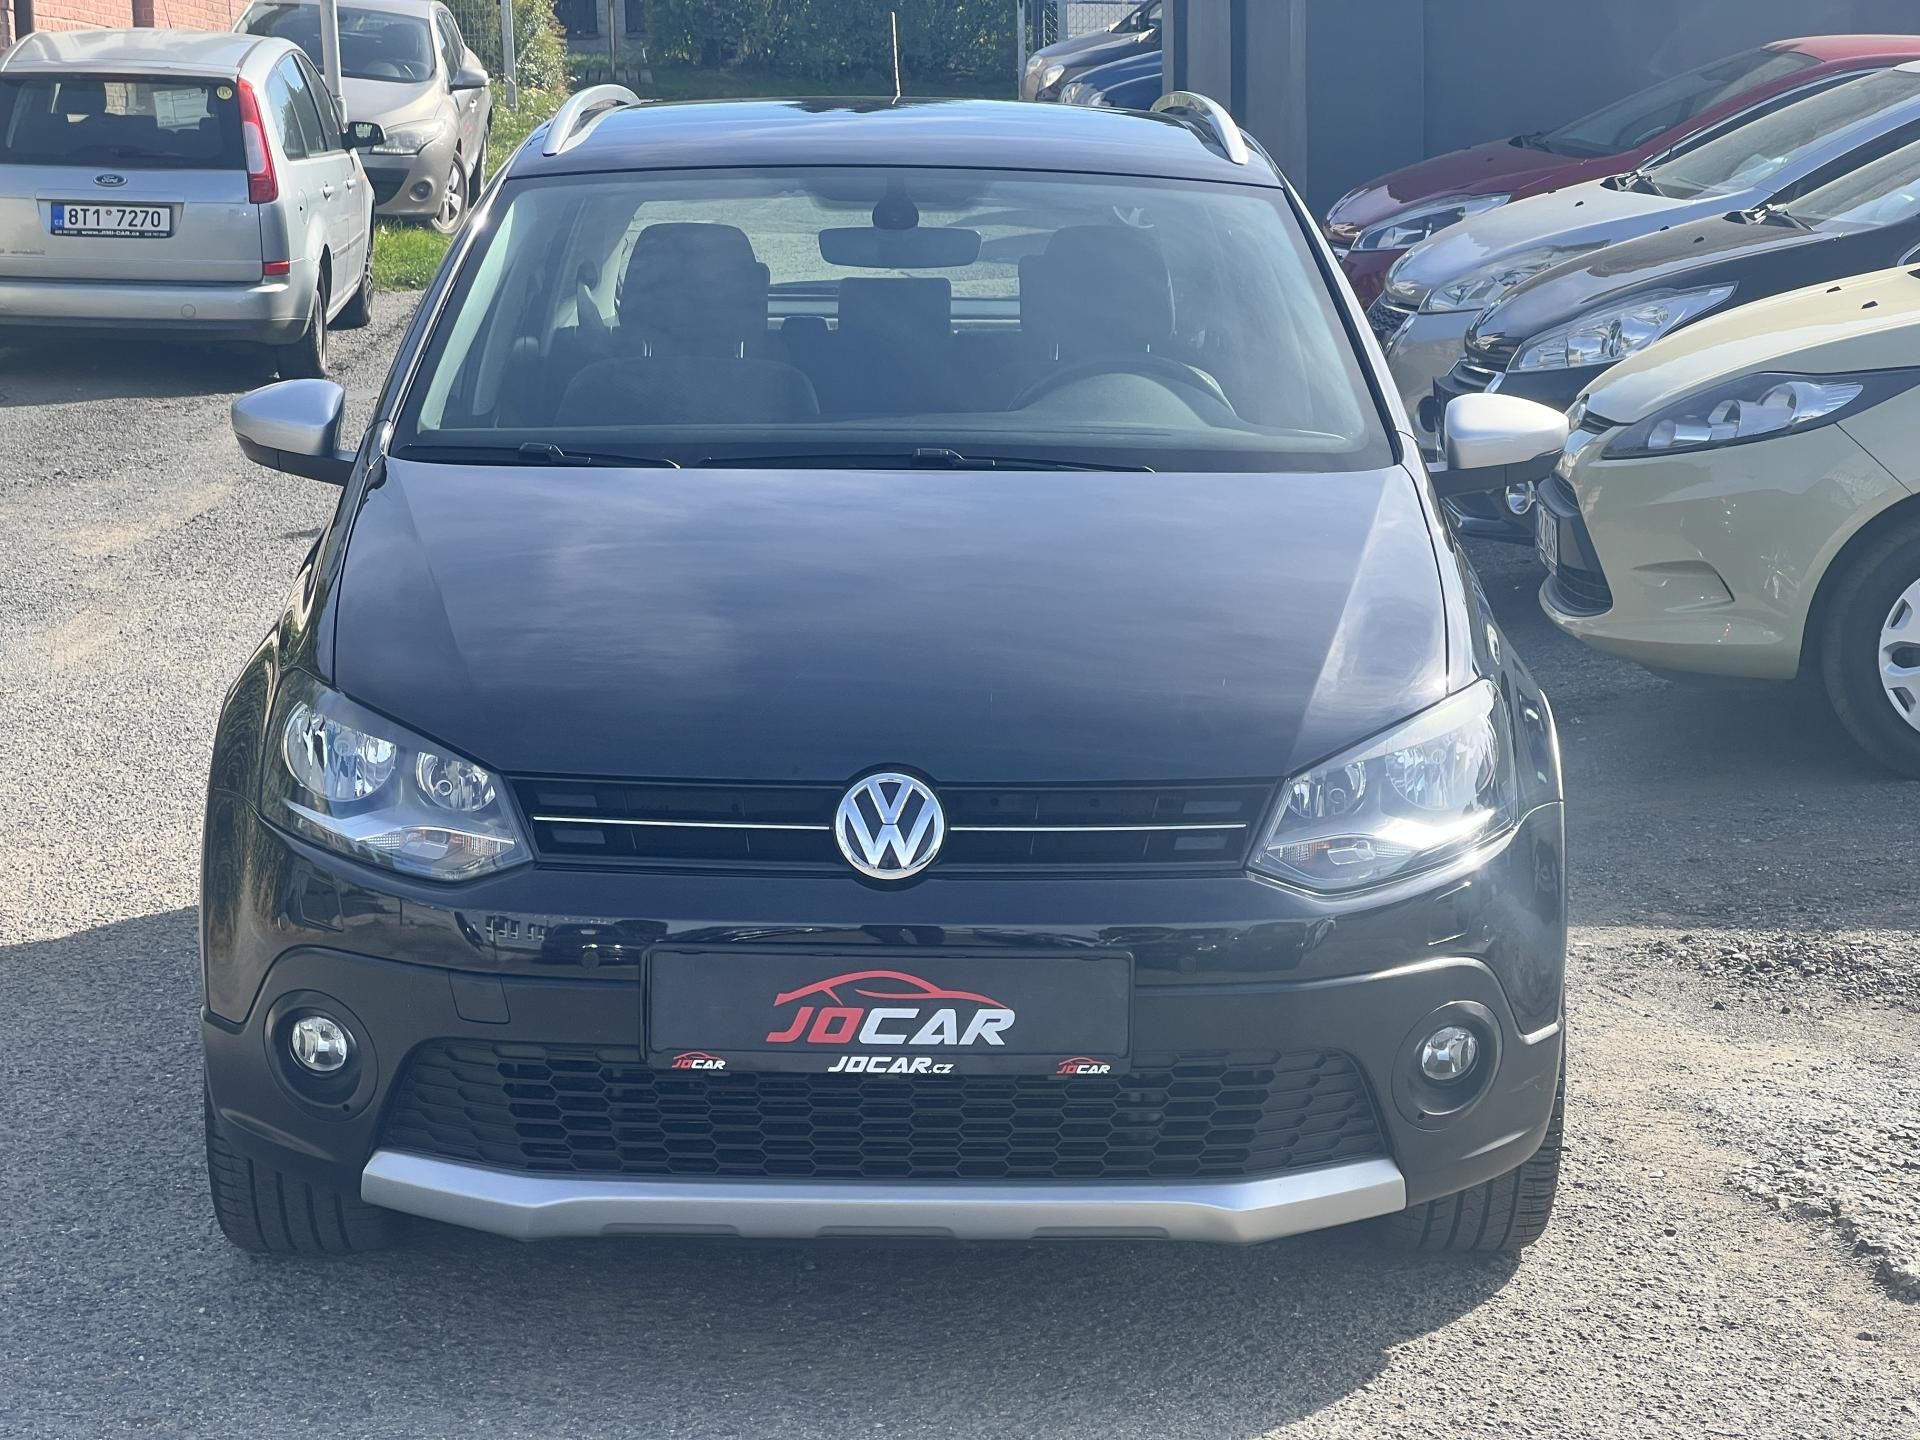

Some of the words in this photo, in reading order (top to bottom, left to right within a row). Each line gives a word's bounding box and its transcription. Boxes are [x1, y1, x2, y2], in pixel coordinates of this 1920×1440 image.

[68, 208, 101, 226] 8T1
[116, 209, 161, 228] 7270
[766, 1006, 1016, 1045] JOCAR
[671, 1059, 726, 1070] JOCAR
[827, 1056, 955, 1074] JOCAR.cz
[1056, 1064, 1111, 1074] JOCAR
